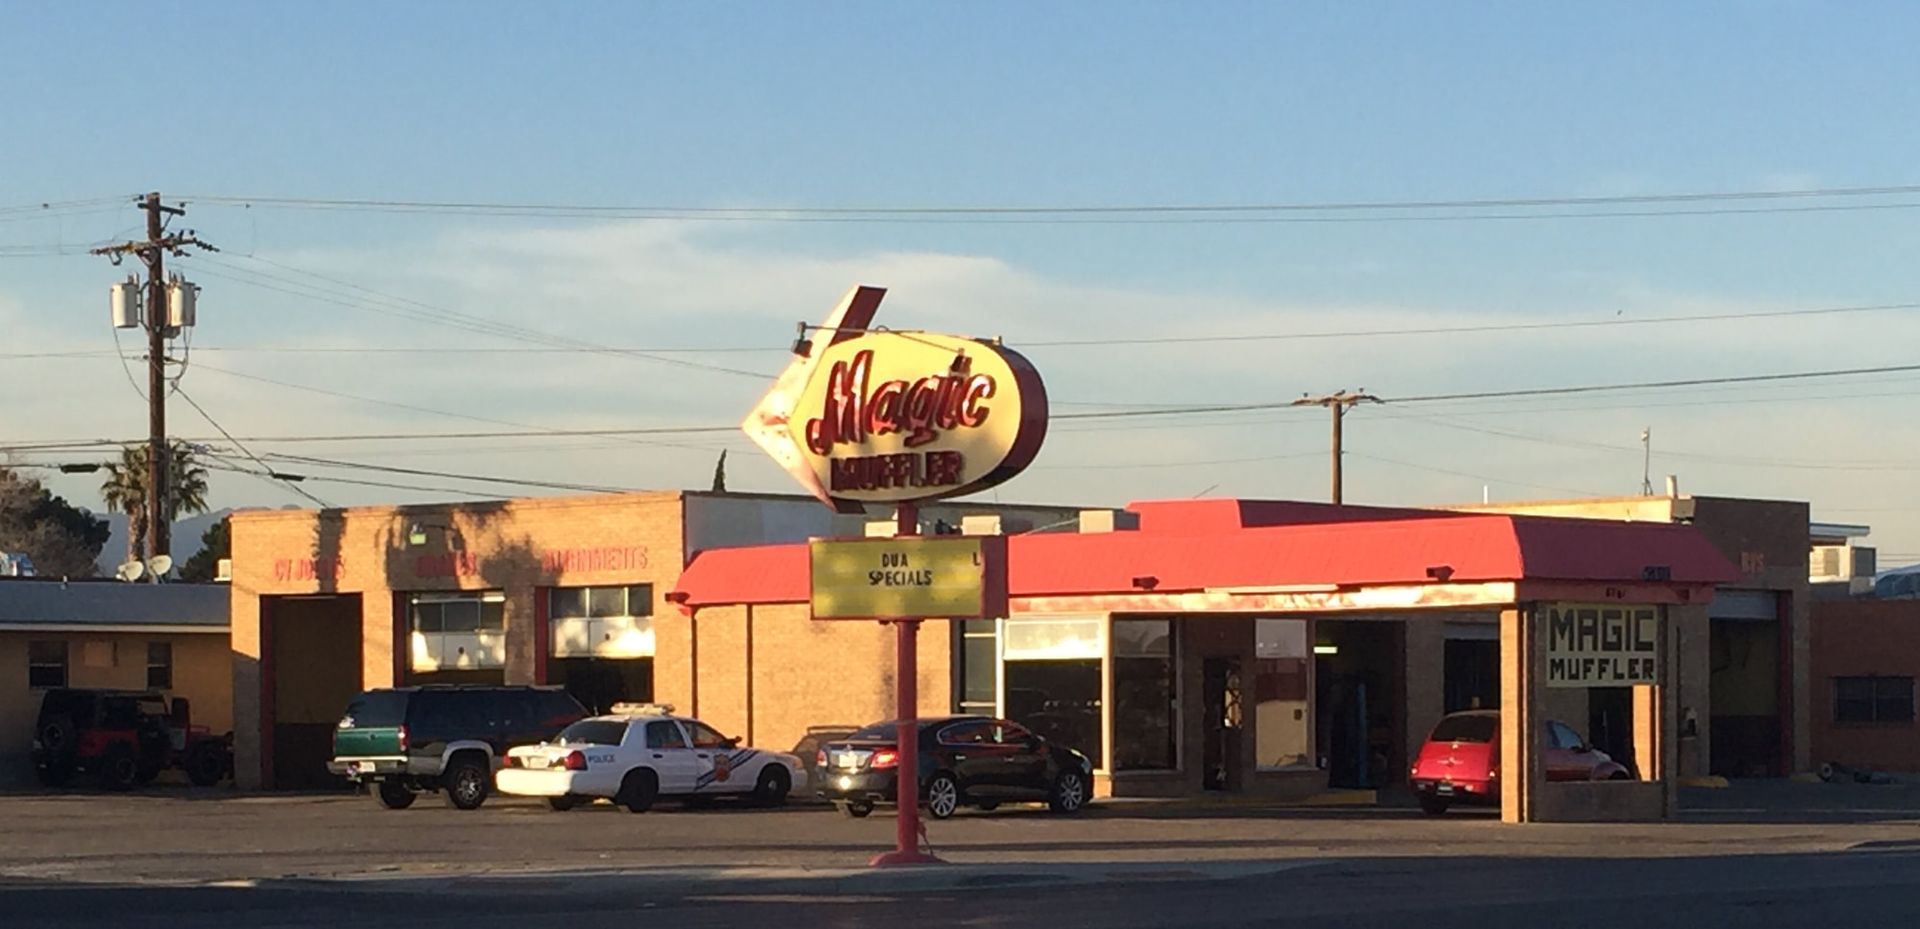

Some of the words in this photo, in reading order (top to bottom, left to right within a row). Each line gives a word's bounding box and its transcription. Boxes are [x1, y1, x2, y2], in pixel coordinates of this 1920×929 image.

[806, 350, 997, 456] Magic
[831, 451, 963, 491] MUFFLER
[294, 557, 346, 581] JOS
[882, 553, 909, 568] DUA
[868, 570, 933, 586] SPECIALS
[1550, 608, 1654, 652] MAGIC
[1550, 658, 1654, 680] MUFFLER
[588, 754, 615, 764] POLICE
